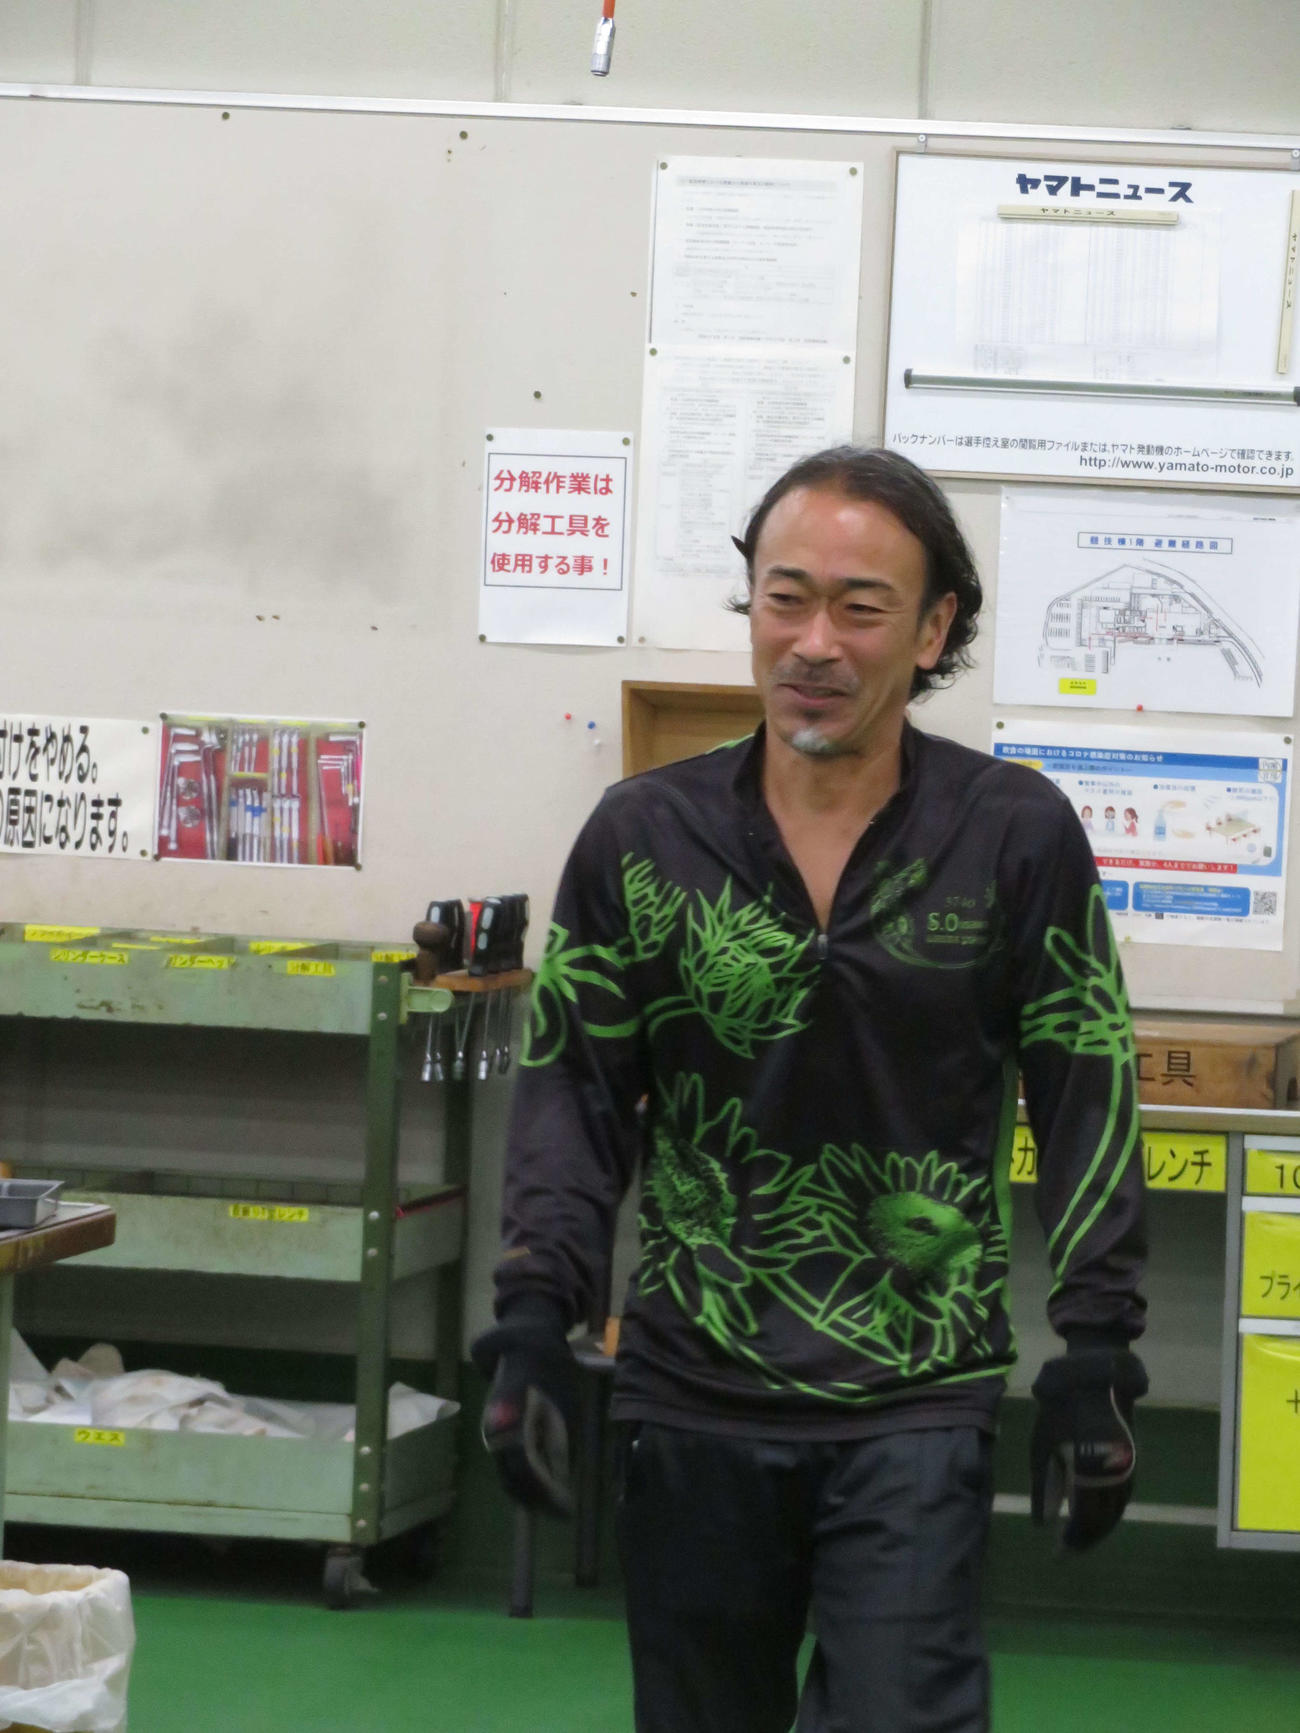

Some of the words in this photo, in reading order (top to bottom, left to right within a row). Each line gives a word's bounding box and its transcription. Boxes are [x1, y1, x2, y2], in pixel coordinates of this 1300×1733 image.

[1016, 173, 1194, 203] ヤマトニュース
[1040, 207, 1116, 216] ヤマトニュース
[1080, 455, 1294, 478] http://www.yamato-motor.co.jp
[494, 469, 613, 496] 分解作業は
[492, 511, 610, 538] 分解工具を
[0, 786, 128, 854] 原因になります。
[1147, 1147, 1212, 1185] レンチ
